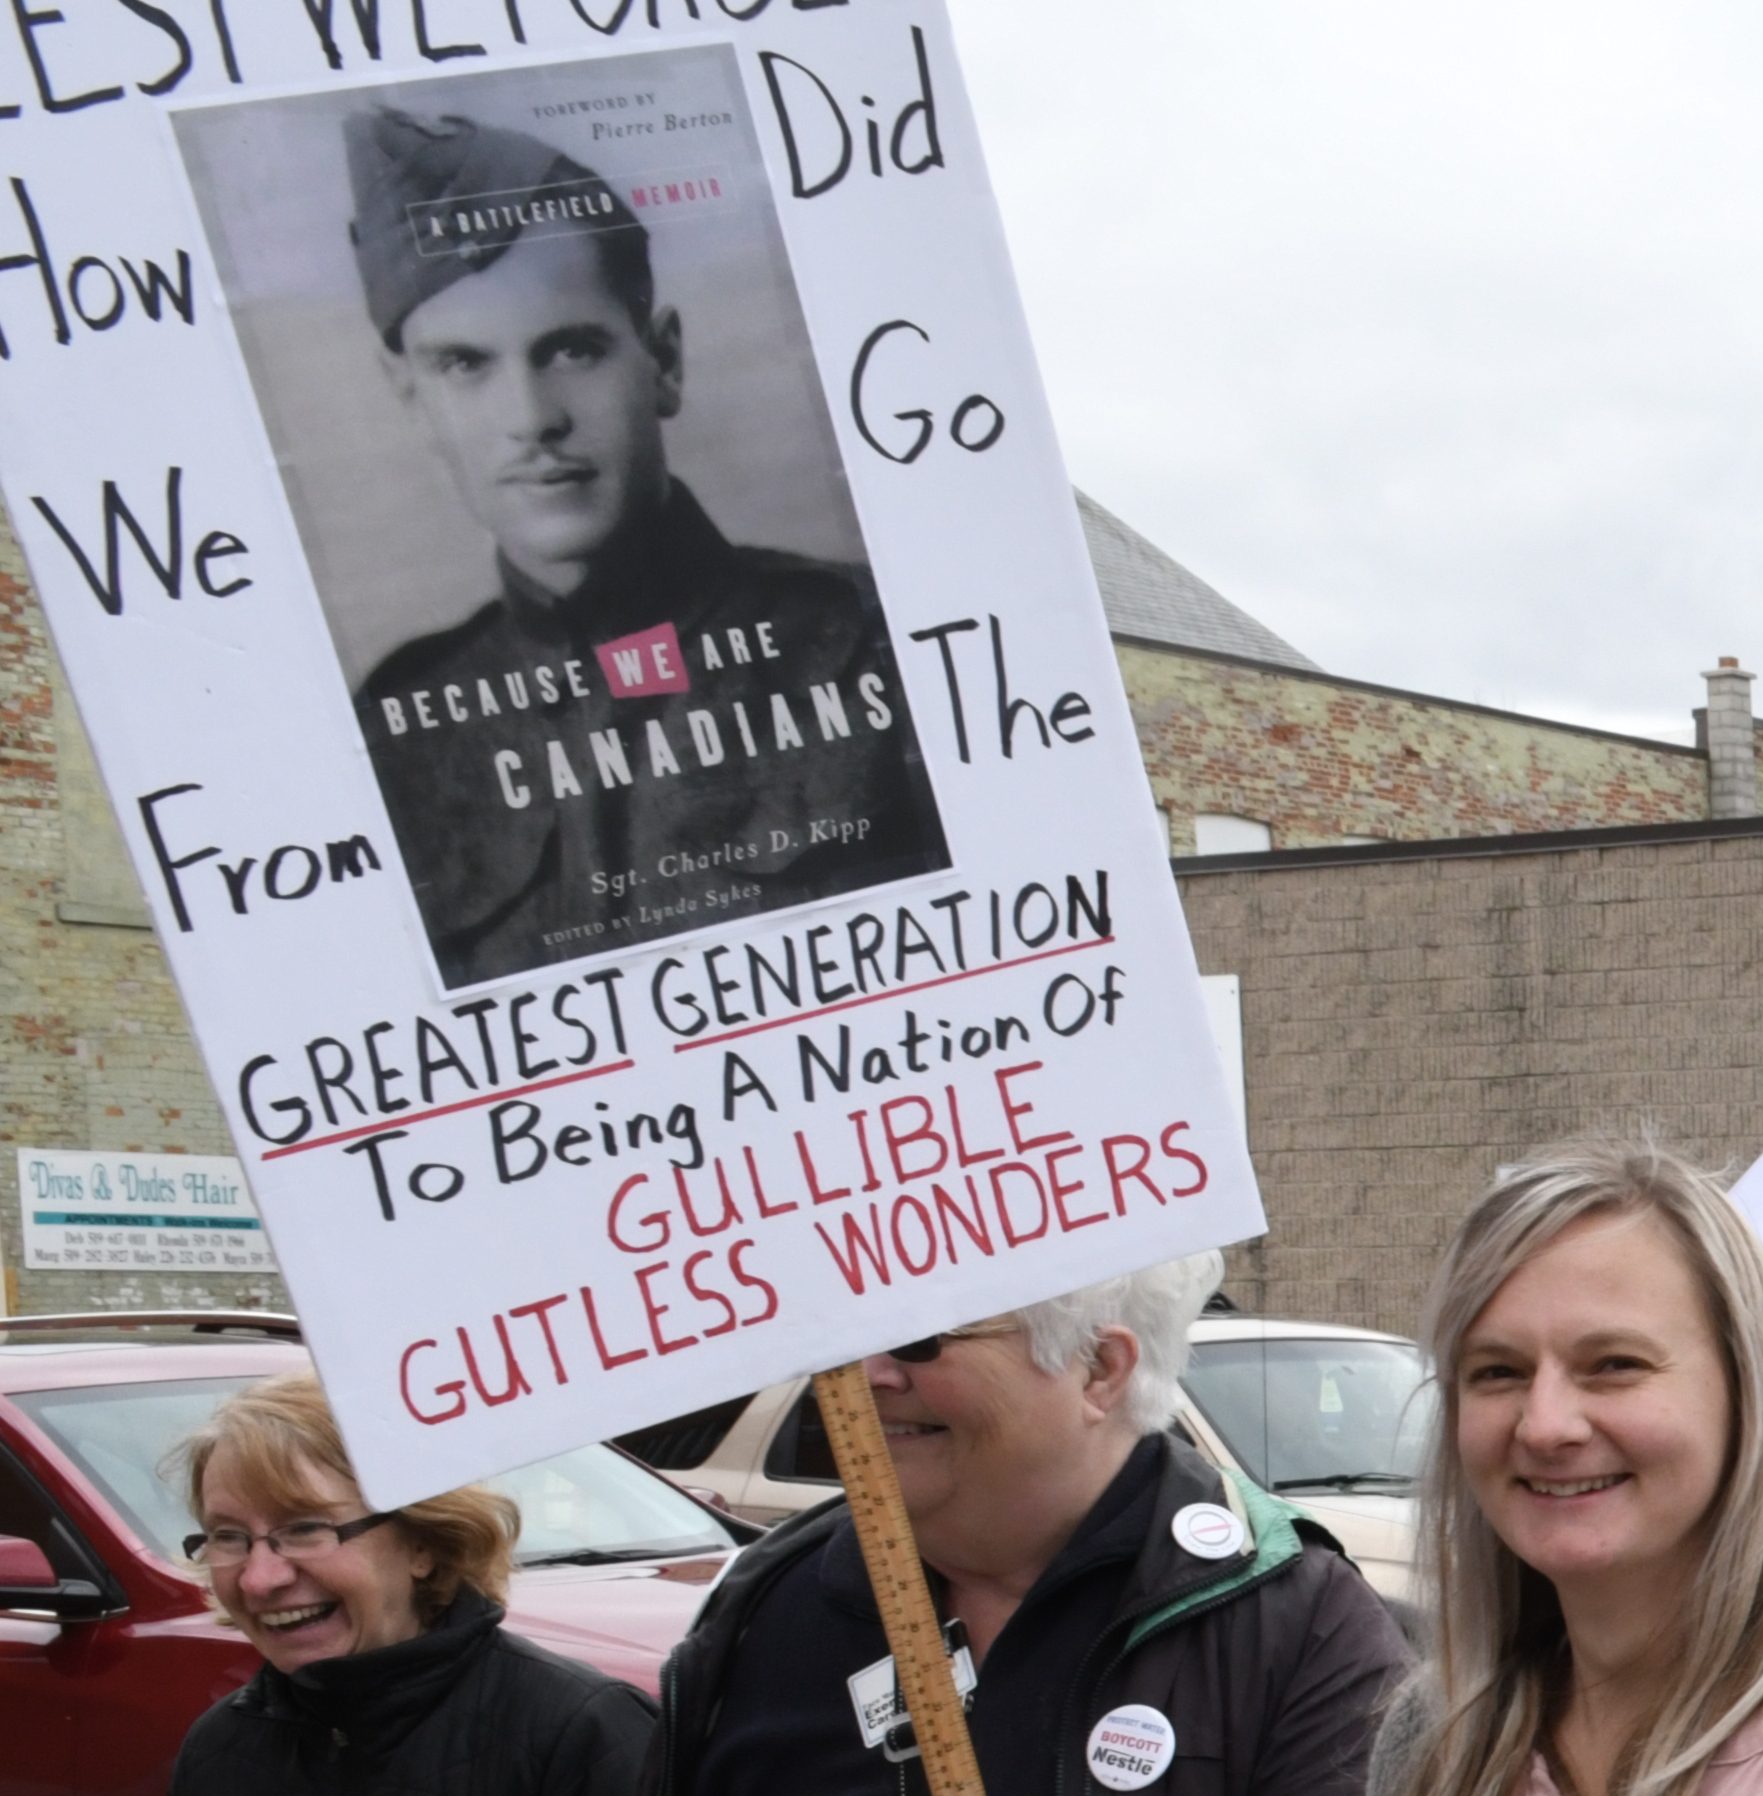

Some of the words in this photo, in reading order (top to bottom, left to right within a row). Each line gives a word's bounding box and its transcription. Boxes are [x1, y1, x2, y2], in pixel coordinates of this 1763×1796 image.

[532, 93, 629, 119] FOREWORD
[635, 91, 656, 106] BY
[591, 119, 655, 140] Pierre
[664, 111, 734, 132] Berton
[758, 25, 944, 199] Did
[0, 177, 194, 359] How
[429, 216, 444, 237] A
[457, 192, 615, 234] BATTLEFIELD
[631, 177, 723, 208] MEMOIR
[850, 319, 1006, 466] Go
[31, 466, 254, 616] We
[381, 660, 590, 735] BECAUSE
[612, 642, 676, 688] WE
[702, 621, 780, 671] ARE
[494, 672, 893, 809] CANADIANS
[909, 615, 1097, 764] The
[138, 783, 383, 935] From
[543, 921, 606, 946] EDITED
[613, 915, 633, 931] BY
[638, 895, 697, 925] Lynda
[705, 881, 762, 908] Sykes
[591, 868, 648, 897] Sgt.
[658, 838, 759, 879] Charles
[771, 828, 799, 854] D.
[810, 815, 872, 845] Kipp
[237, 967, 628, 1147] GREATEST
[650, 870, 1112, 1038] GENERATION
[345, 1131, 465, 1222] To
[489, 1099, 705, 1184] Being
[720, 1051, 777, 1121] A
[799, 1007, 1030, 1103] Nation
[1043, 965, 1127, 1037] Of
[606, 1060, 1075, 1254] GULLIBLE
[29, 1161, 84, 1200] Divas
[90, 1163, 113, 1201] &
[118, 1164, 176, 1203] Dudes
[182, 1172, 240, 1206] Hair
[399, 1238, 780, 1426] GUTLESS
[815, 1120, 1210, 1296] WONDERS
[1100, 1730, 1163, 1754] BOYCOTT
